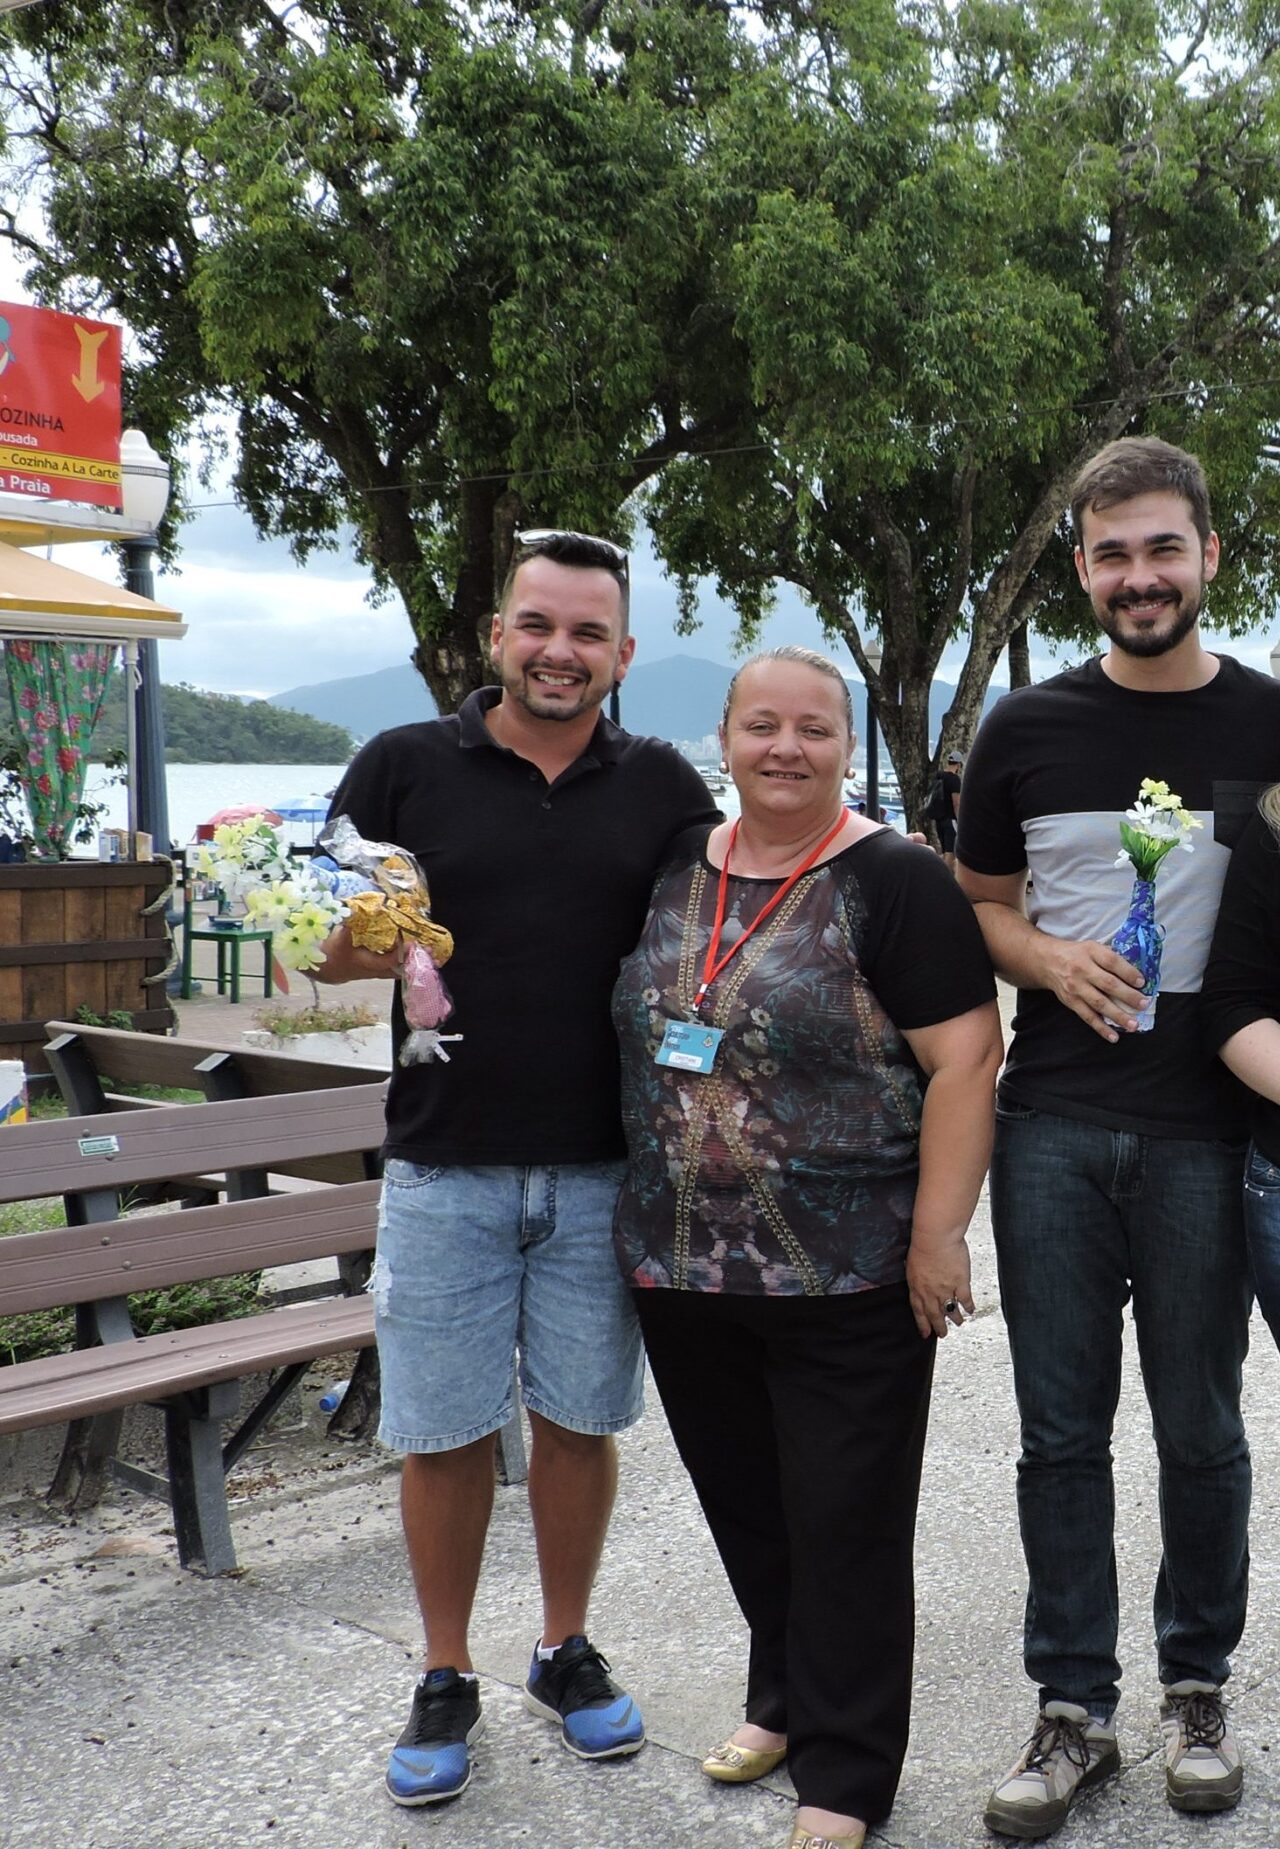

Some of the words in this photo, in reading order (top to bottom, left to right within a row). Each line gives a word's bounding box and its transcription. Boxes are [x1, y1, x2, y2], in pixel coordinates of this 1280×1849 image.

[11, 453, 58, 470] Cozinha
[62, 462, 69, 471] A
[73, 463, 85, 474] La
[89, 465, 119, 479] Carte
[10, 475, 50, 494] Praia
